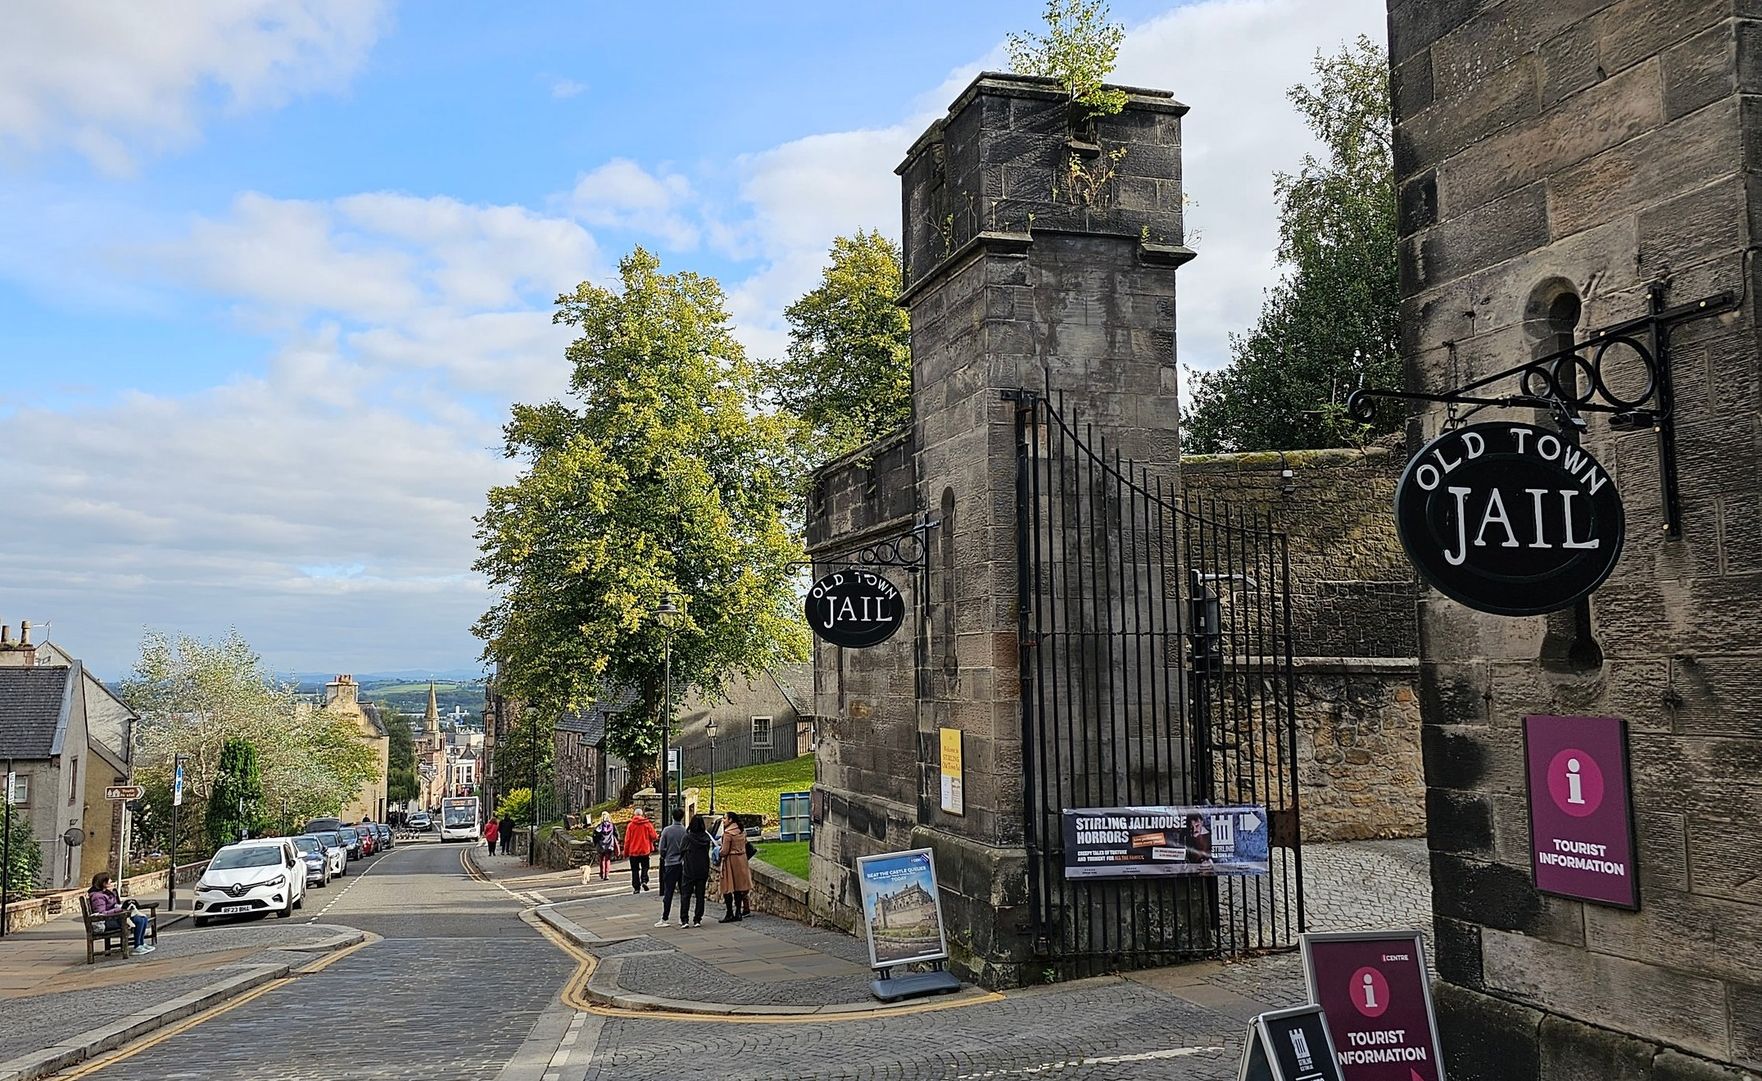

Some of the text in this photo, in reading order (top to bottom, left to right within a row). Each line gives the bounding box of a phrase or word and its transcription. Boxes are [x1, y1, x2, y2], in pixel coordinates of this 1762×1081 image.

[1416, 427, 1608, 496] OLD TOWN
[1443, 486, 1600, 566] JAIL
[812, 571, 898, 600] OLD TOWN
[823, 595, 893, 629] JAIL
[1075, 815, 1188, 831] STIRLING JAILHOUSE
[1076, 830, 1130, 845] HORRORS
[1552, 838, 1607, 857] TOURIST
[1539, 851, 1625, 876] INFORMATION
[1347, 1029, 1405, 1046] TOURIST
[1337, 1046, 1427, 1066] NFORMATION
